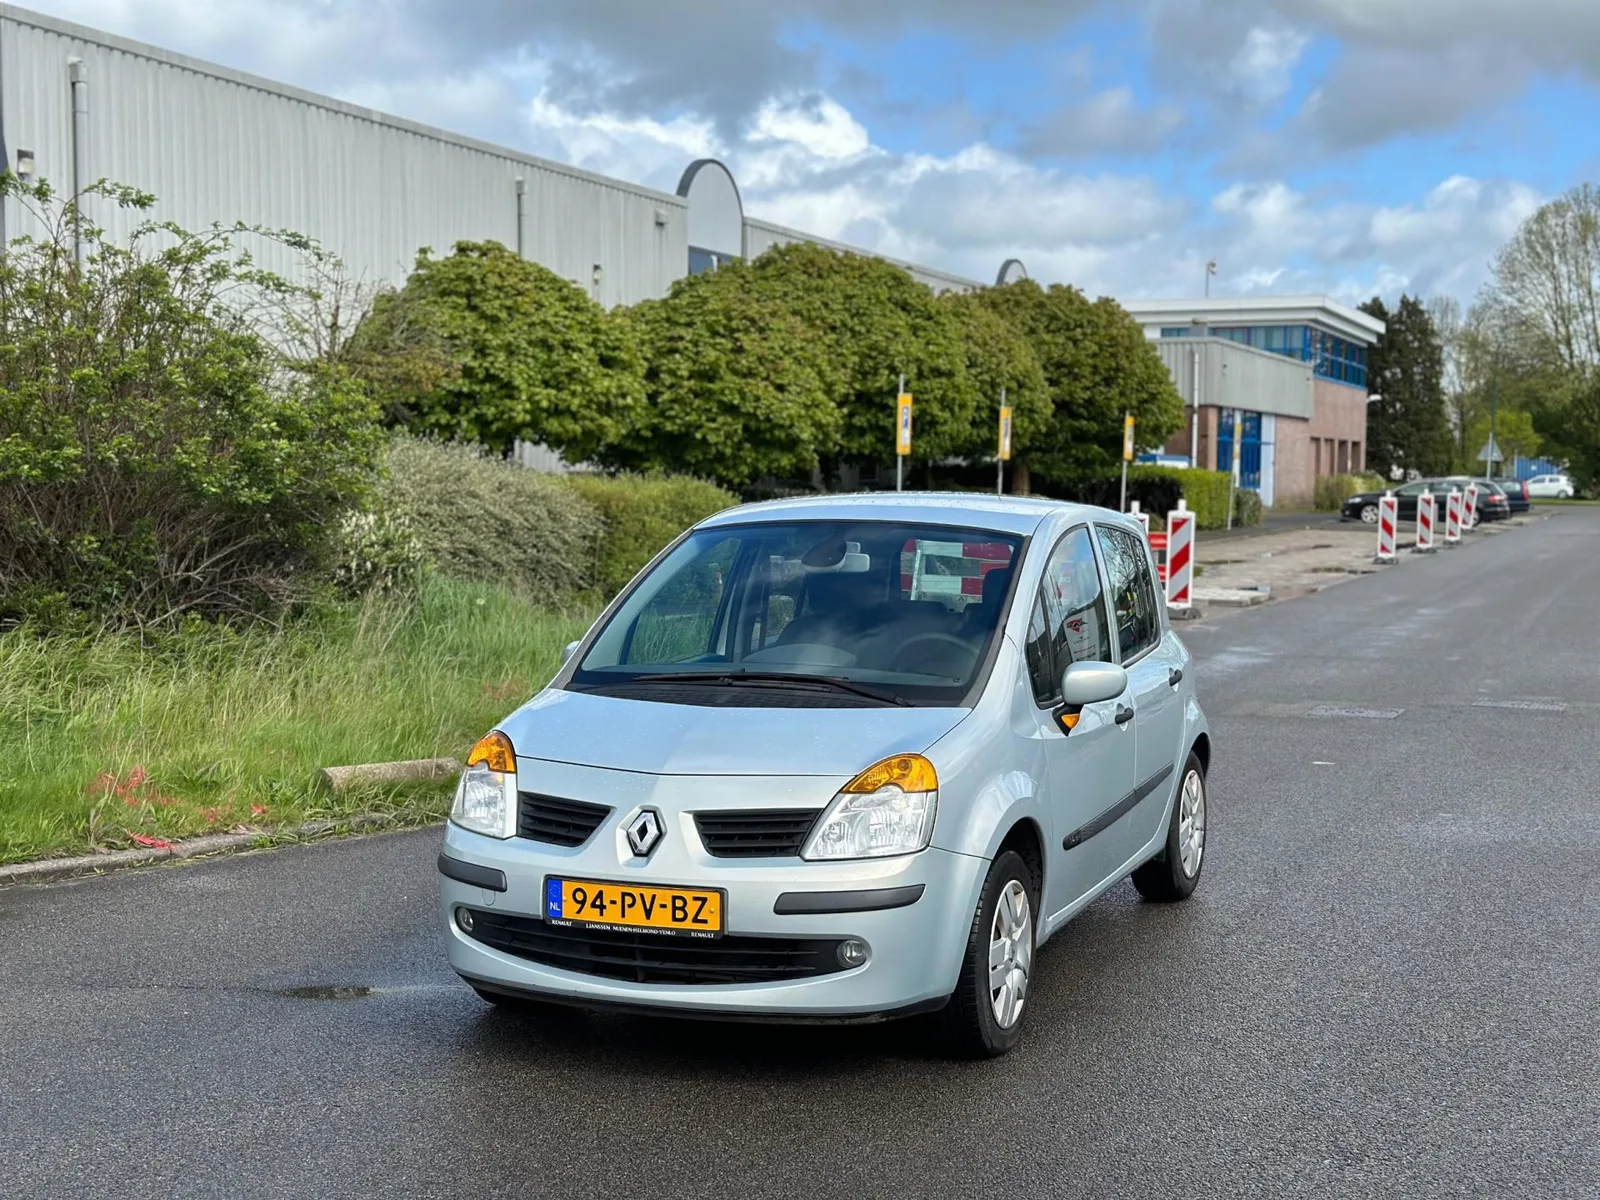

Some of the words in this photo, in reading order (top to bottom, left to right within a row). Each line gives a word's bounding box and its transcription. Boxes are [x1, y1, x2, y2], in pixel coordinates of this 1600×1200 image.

[549, 902, 560, 911] NL
[572, 887, 708, 924] 94-PV-BZ
[551, 919, 573, 927] RENAULT
